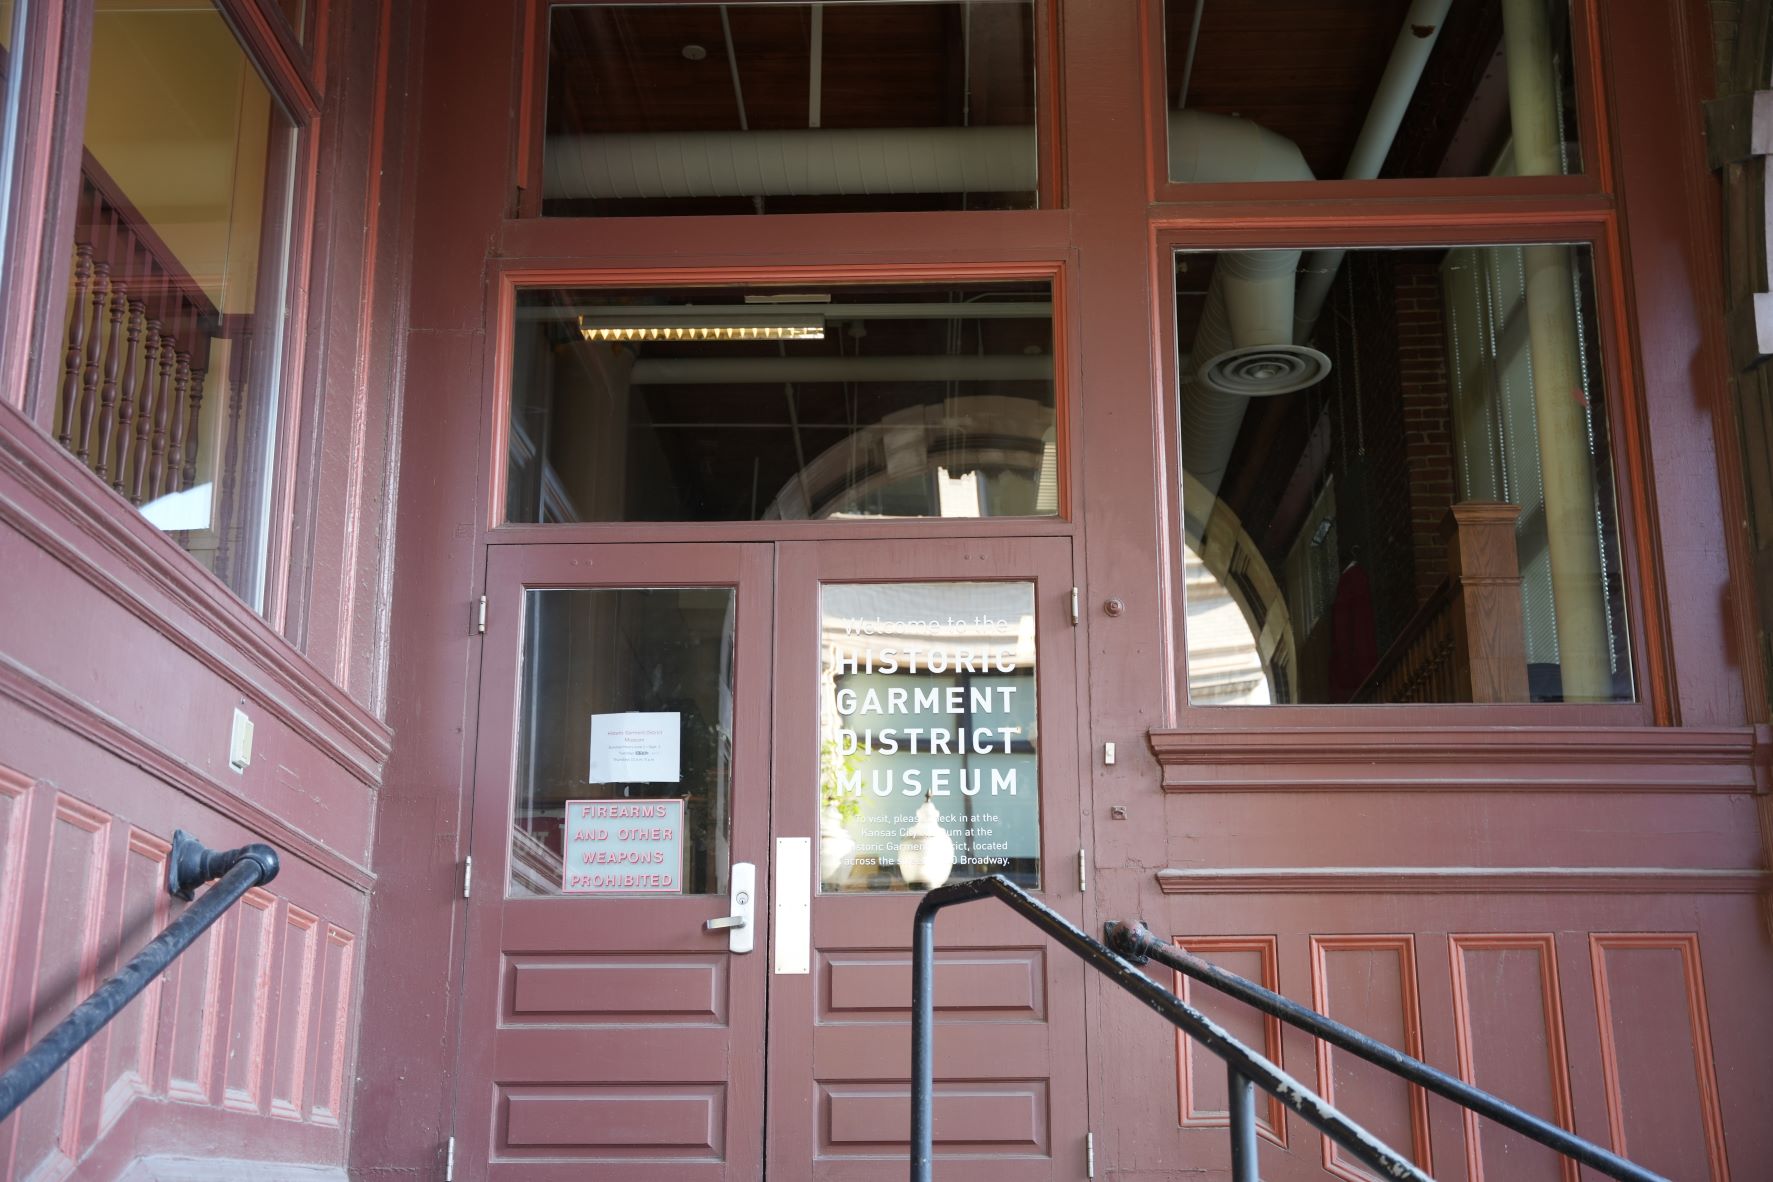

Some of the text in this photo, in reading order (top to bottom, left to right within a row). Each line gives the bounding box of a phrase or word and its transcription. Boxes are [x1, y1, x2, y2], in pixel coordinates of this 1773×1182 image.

[842, 615, 1008, 636] Welcome to the
[837, 648, 1016, 675] HISTORIC
[836, 686, 1017, 715] GARMENT
[837, 727, 1017, 756] DISTRICT
[836, 768, 1017, 797] MUSEUM
[582, 805, 667, 818] FIREARMS
[868, 814, 891, 824] visit,
[893, 814, 921, 825] pleas
[959, 814, 968, 823] in
[970, 814, 980, 823] at
[981, 813, 998, 823] the
[574, 827, 673, 841] AND OTHER
[861, 828, 897, 837] Kansas
[964, 828, 974, 837] at
[976, 827, 993, 837] the
[886, 842, 925, 851] Garmen
[972, 841, 1008, 851] located
[583, 851, 664, 864] WEAPONS
[843, 856, 876, 865] across
[879, 855, 894, 865] the
[960, 855, 1010, 867] Broadway.
[571, 874, 673, 887] PROHIBITED
